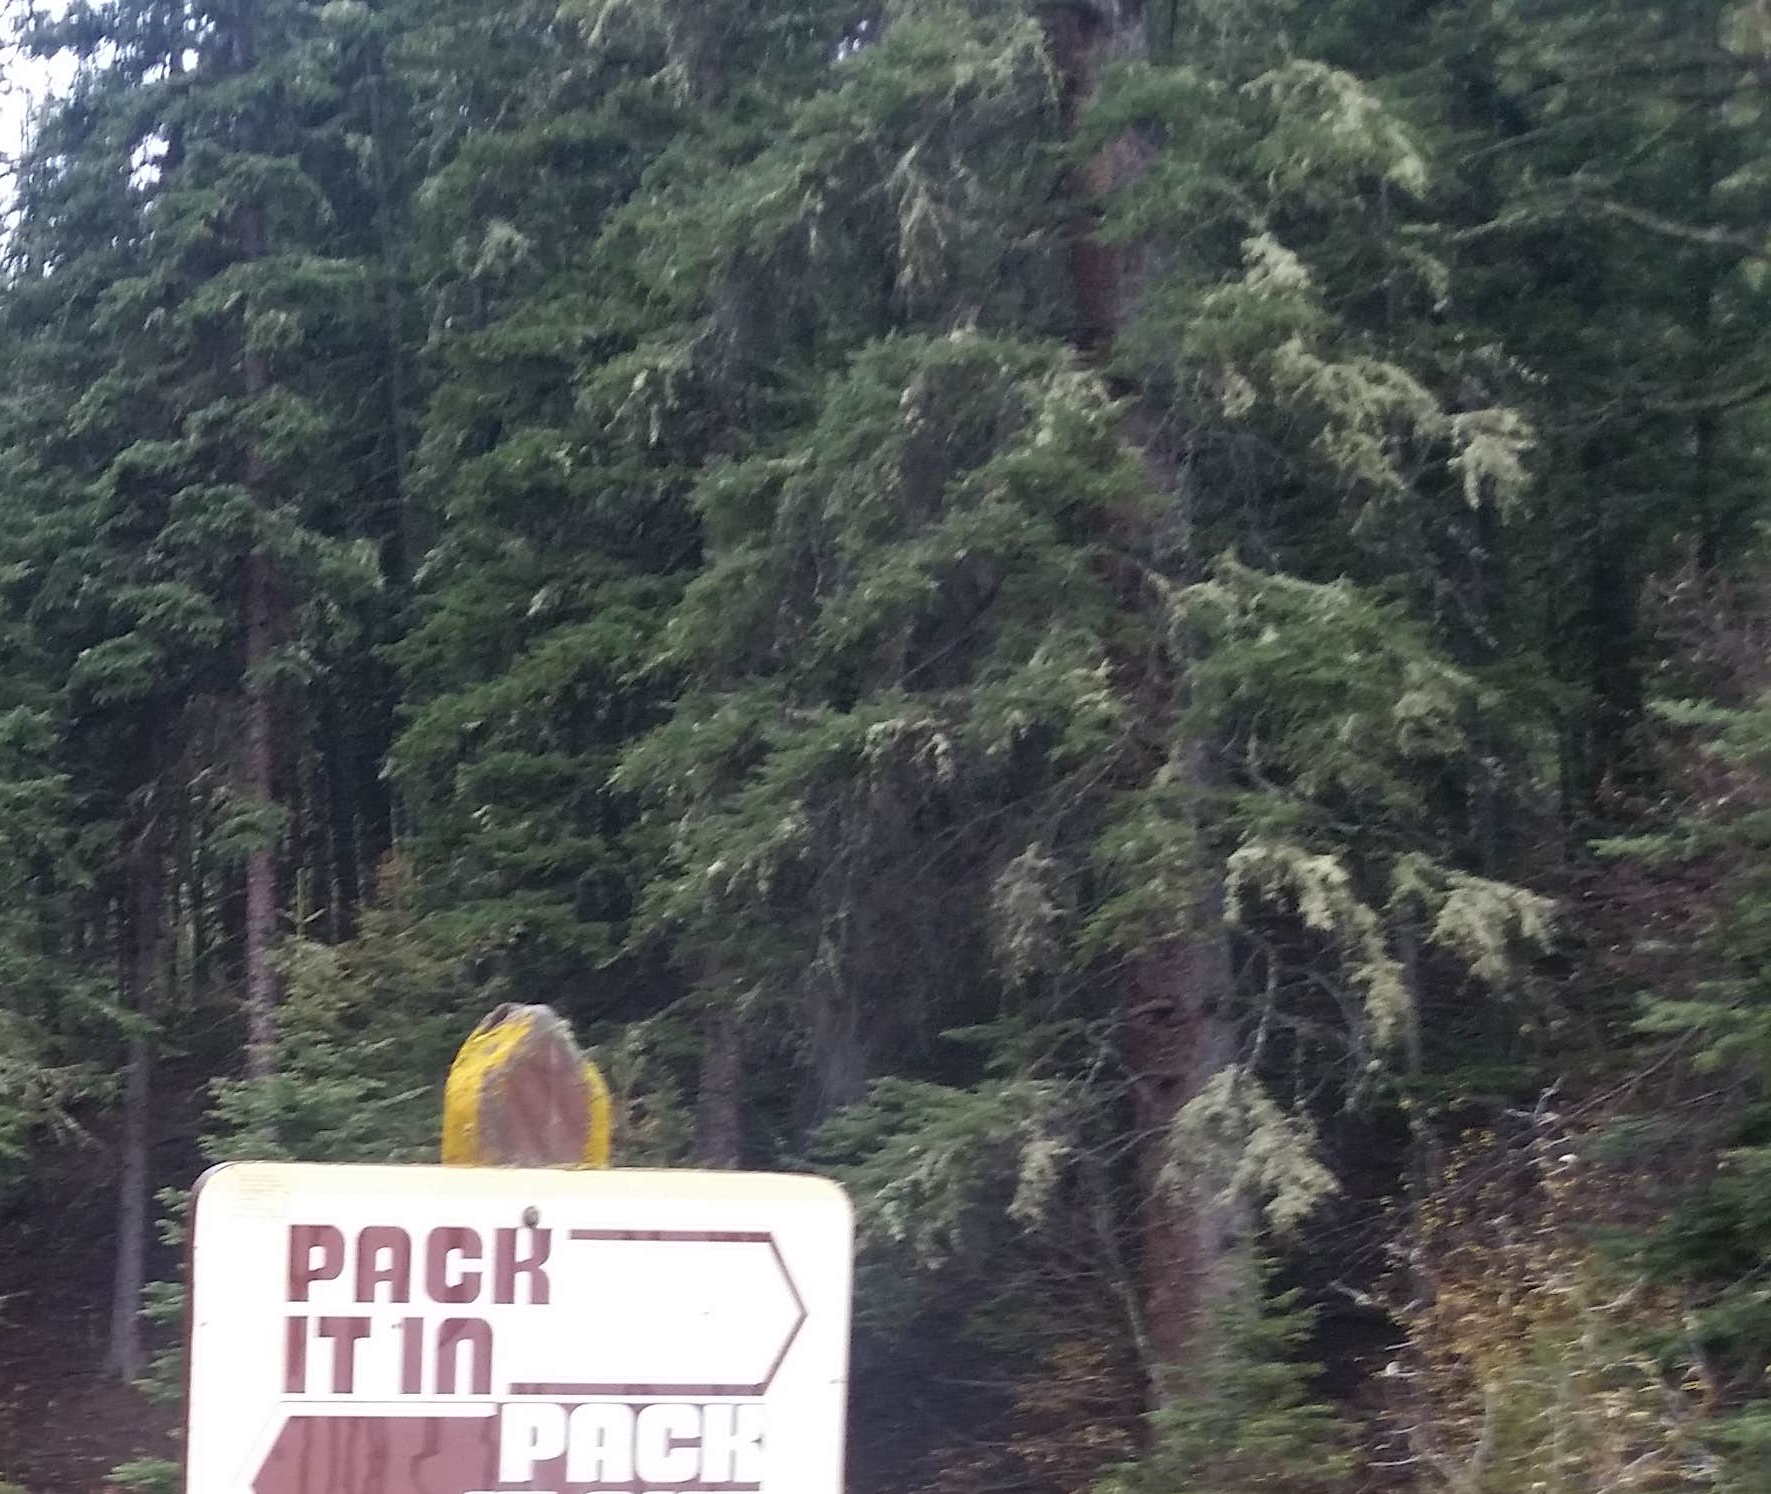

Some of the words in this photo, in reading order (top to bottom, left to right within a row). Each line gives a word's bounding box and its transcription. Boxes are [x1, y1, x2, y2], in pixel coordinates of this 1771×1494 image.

[286, 1223, 552, 1304] PACK
[284, 1316, 371, 1395] IT
[393, 1316, 494, 1395] IN
[498, 1403, 767, 1484] PACK
